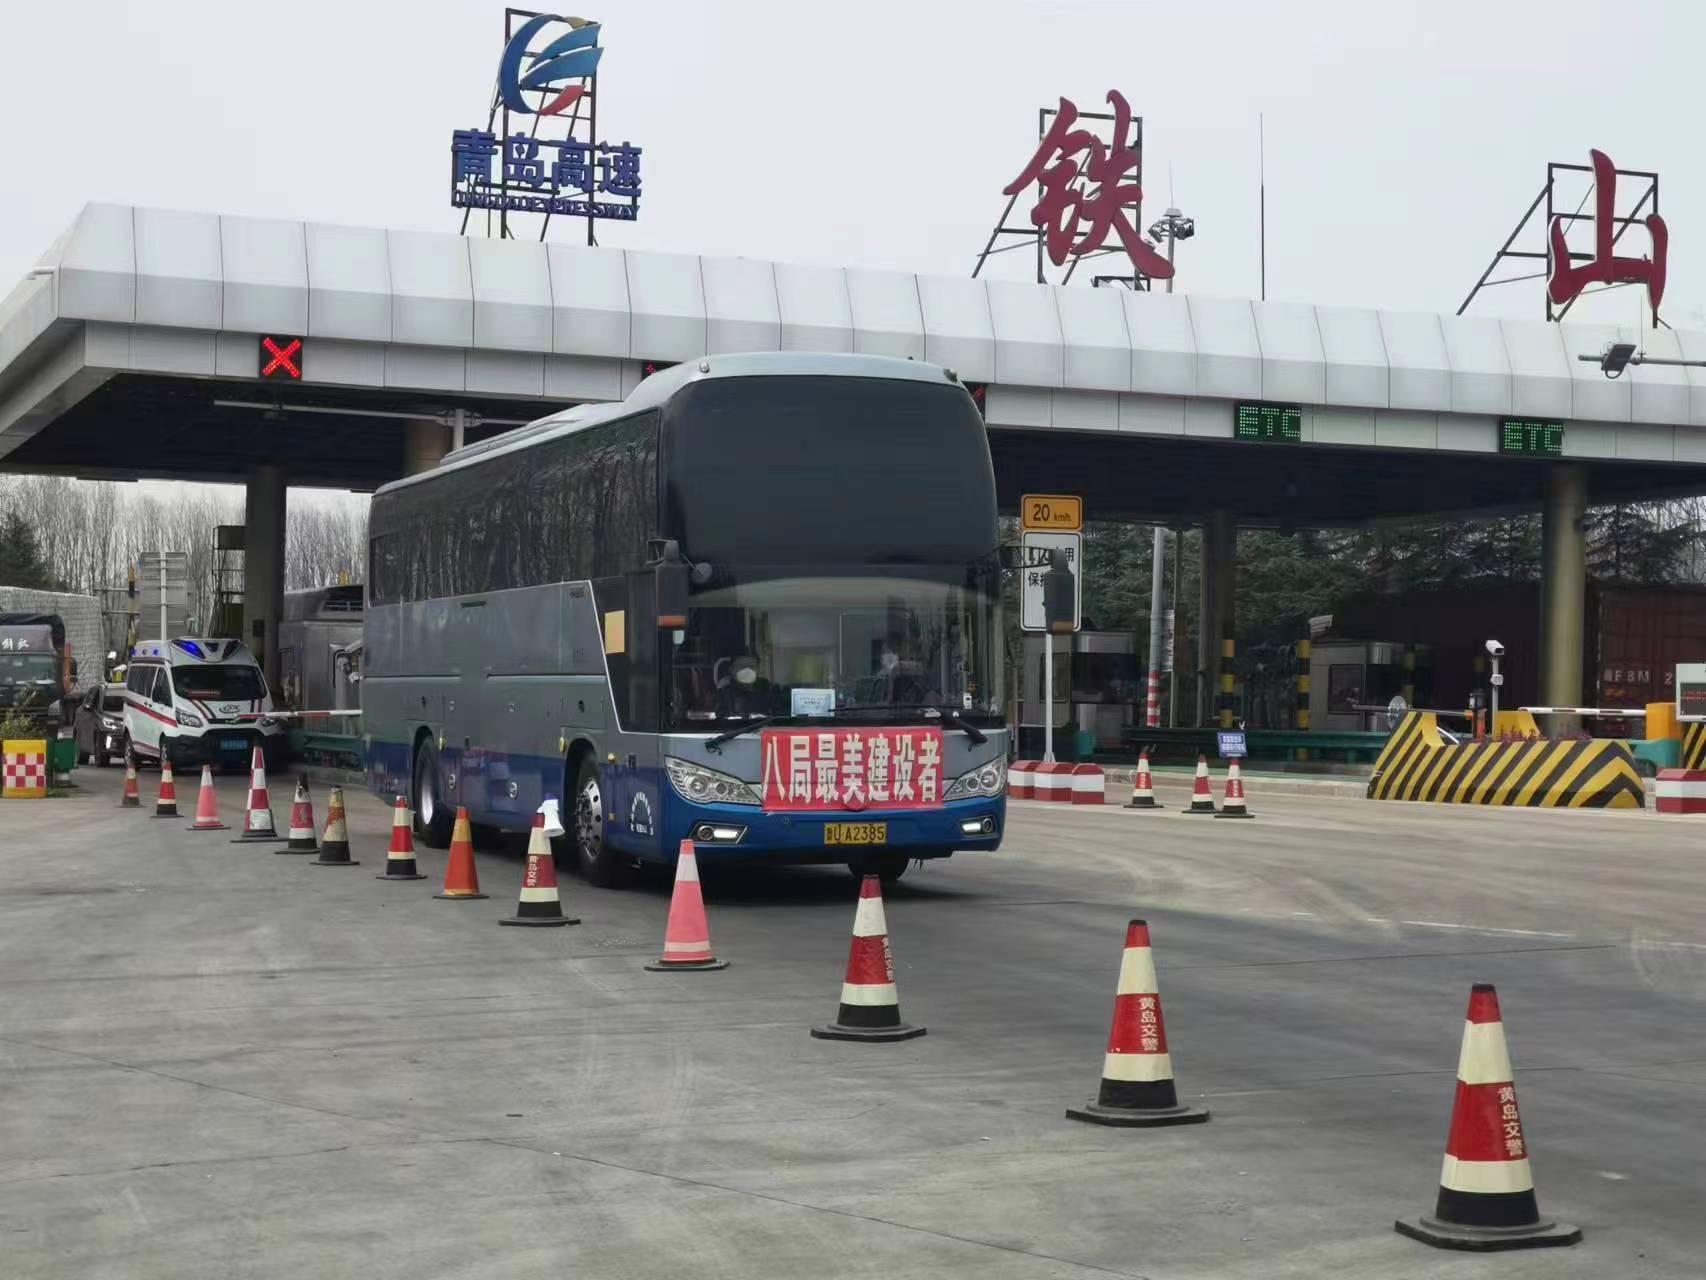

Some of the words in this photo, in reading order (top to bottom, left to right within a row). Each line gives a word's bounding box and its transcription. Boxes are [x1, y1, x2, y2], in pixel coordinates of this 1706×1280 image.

[451, 128, 642, 197] 青岛高速
[1003, 89, 1175, 279] 铁
[1549, 148, 1668, 310] 山
[1239, 406, 1301, 437] ETC
[1504, 422, 1562, 451] ETC
[1033, 504, 1050, 521] 20
[1054, 512, 1072, 522] km/h
[762, 733, 941, 804] 八局最美建设者
[1138, 997, 1159, 1051] 黄岛交警
[1499, 1086, 1523, 1157] 黄岛交警
